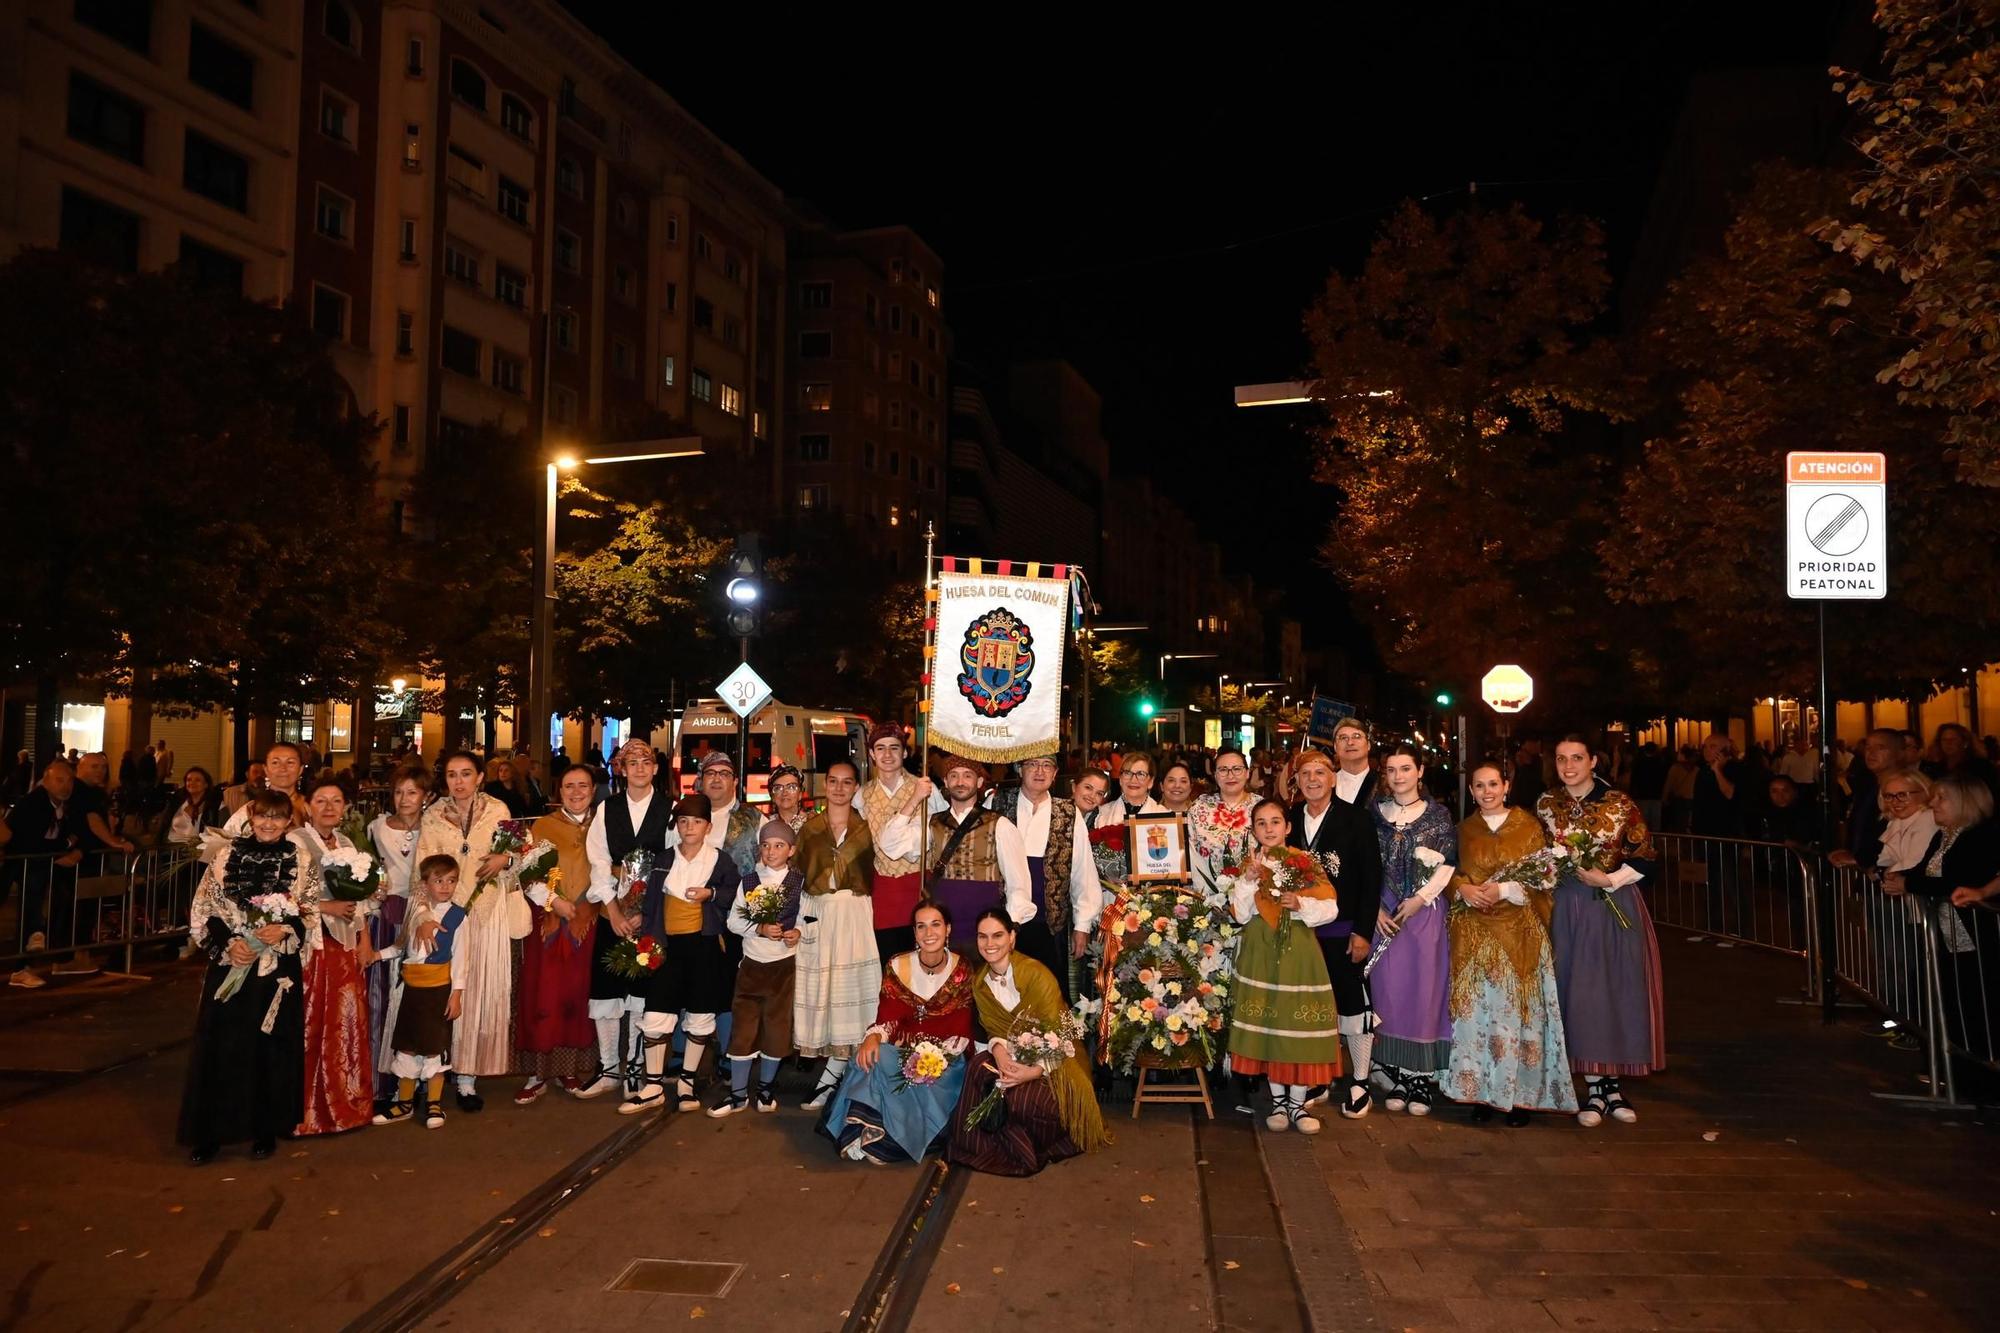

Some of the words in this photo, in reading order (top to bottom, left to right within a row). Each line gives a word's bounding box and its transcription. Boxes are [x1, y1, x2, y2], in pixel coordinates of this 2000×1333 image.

[1799, 462, 1873, 473] ATENCIÓN
[1799, 562, 1876, 572] PRIORIDAD
[1800, 579, 1875, 589] PEATONAL
[946, 586, 985, 599] HUESA
[989, 586, 1010, 598] DEL
[1015, 587, 1059, 606] COMUN
[732, 681, 755, 699] 30
[971, 723, 1014, 738] TERUEL
